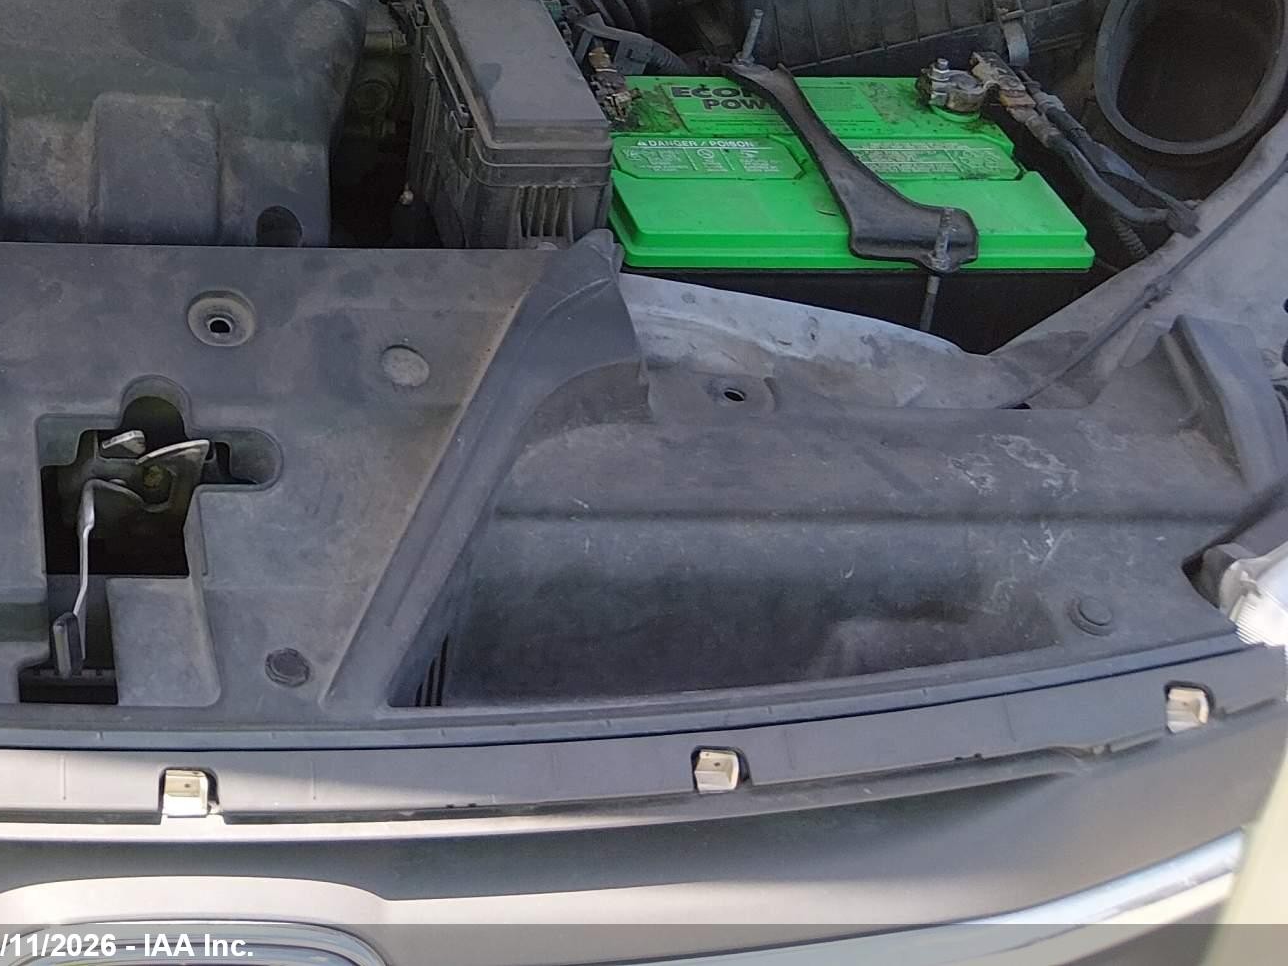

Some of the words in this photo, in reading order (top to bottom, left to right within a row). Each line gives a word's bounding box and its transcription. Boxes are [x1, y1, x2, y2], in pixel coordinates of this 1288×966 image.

[701, 98, 766, 111] POW
[648, 139, 697, 148] DANGER
[708, 139, 754, 149] POISON
